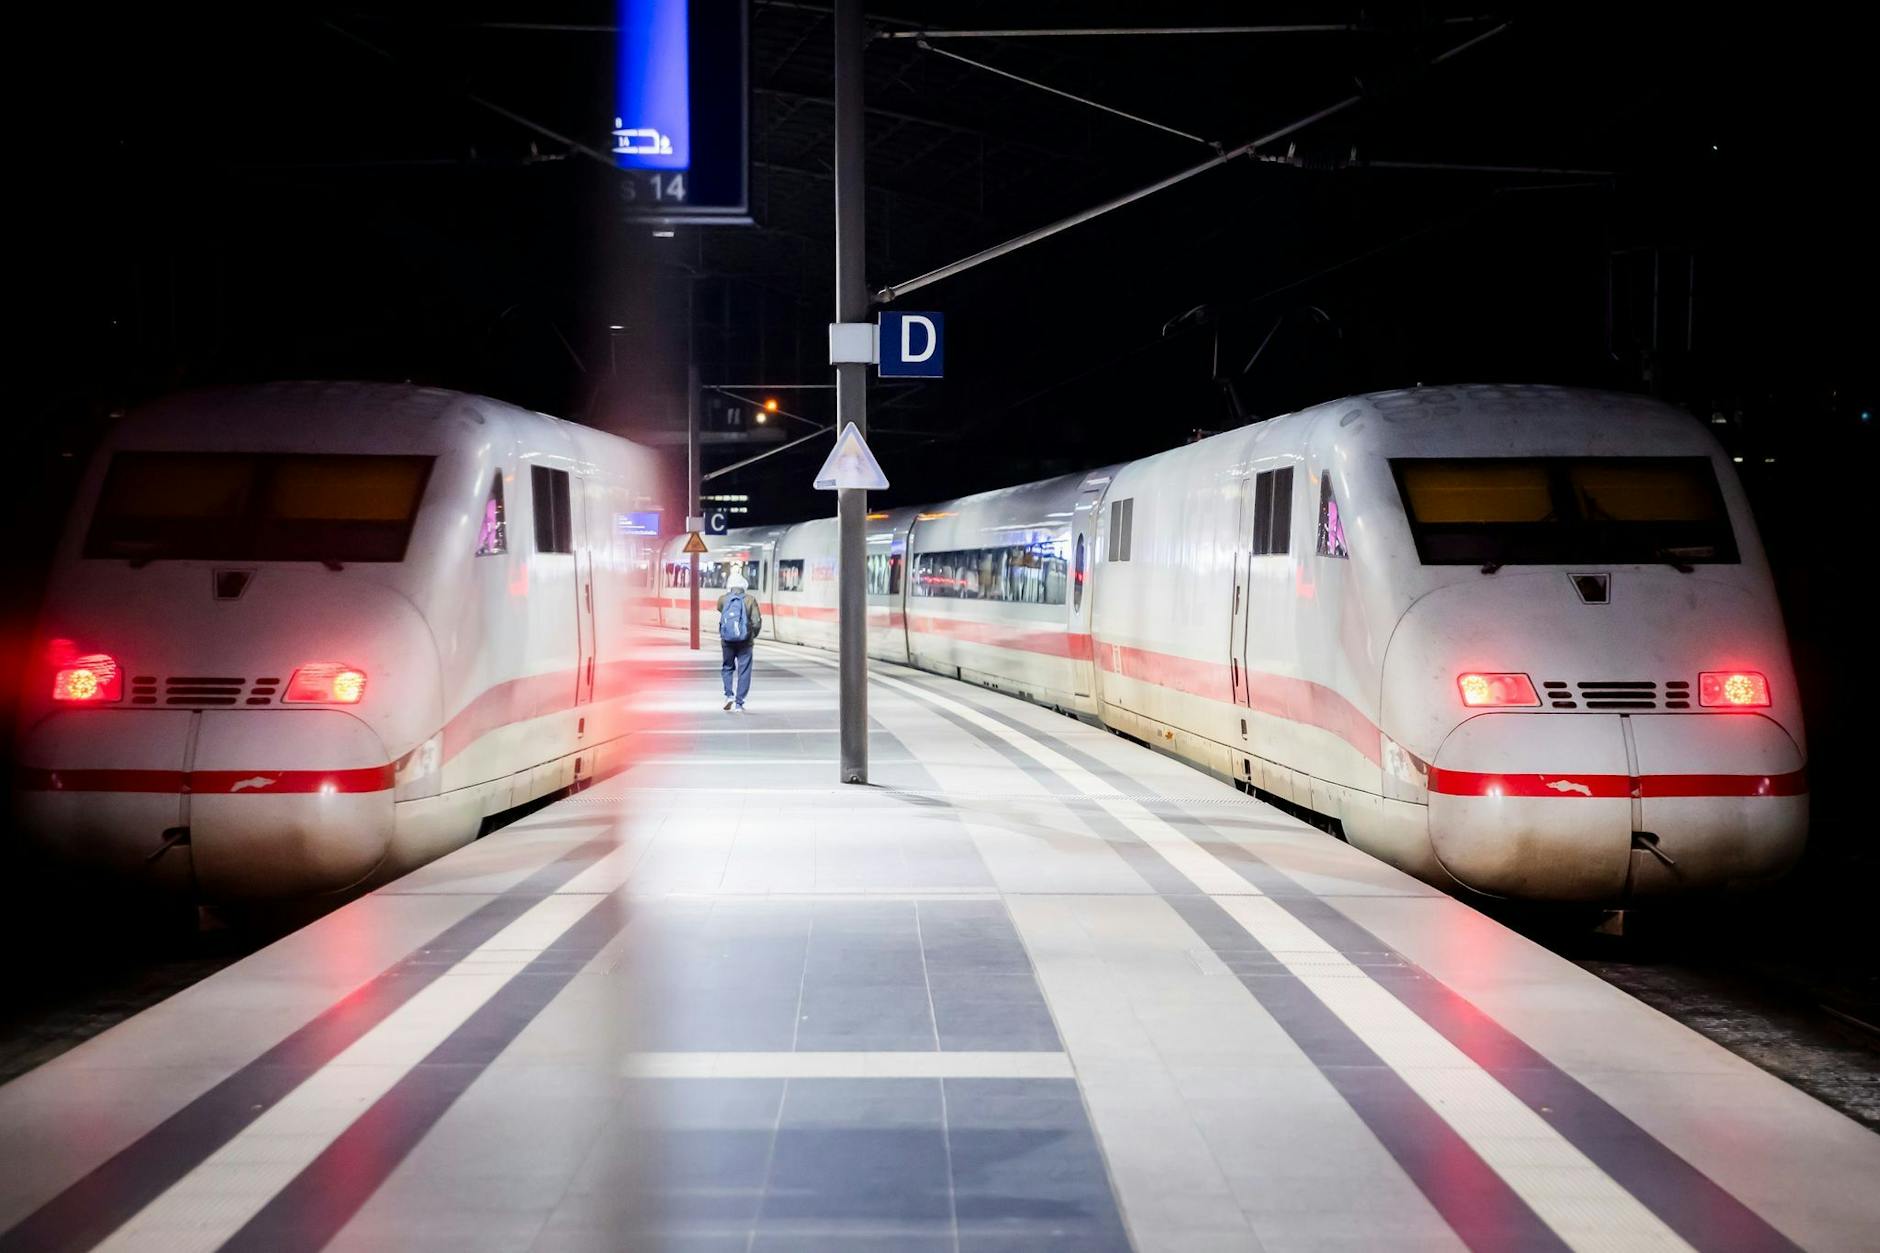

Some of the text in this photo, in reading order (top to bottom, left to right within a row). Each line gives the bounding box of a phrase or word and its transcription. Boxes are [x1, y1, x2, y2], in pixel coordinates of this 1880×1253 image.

[650, 173, 687, 202] 14
[901, 315, 937, 363] D
[711, 513, 725, 532] C
